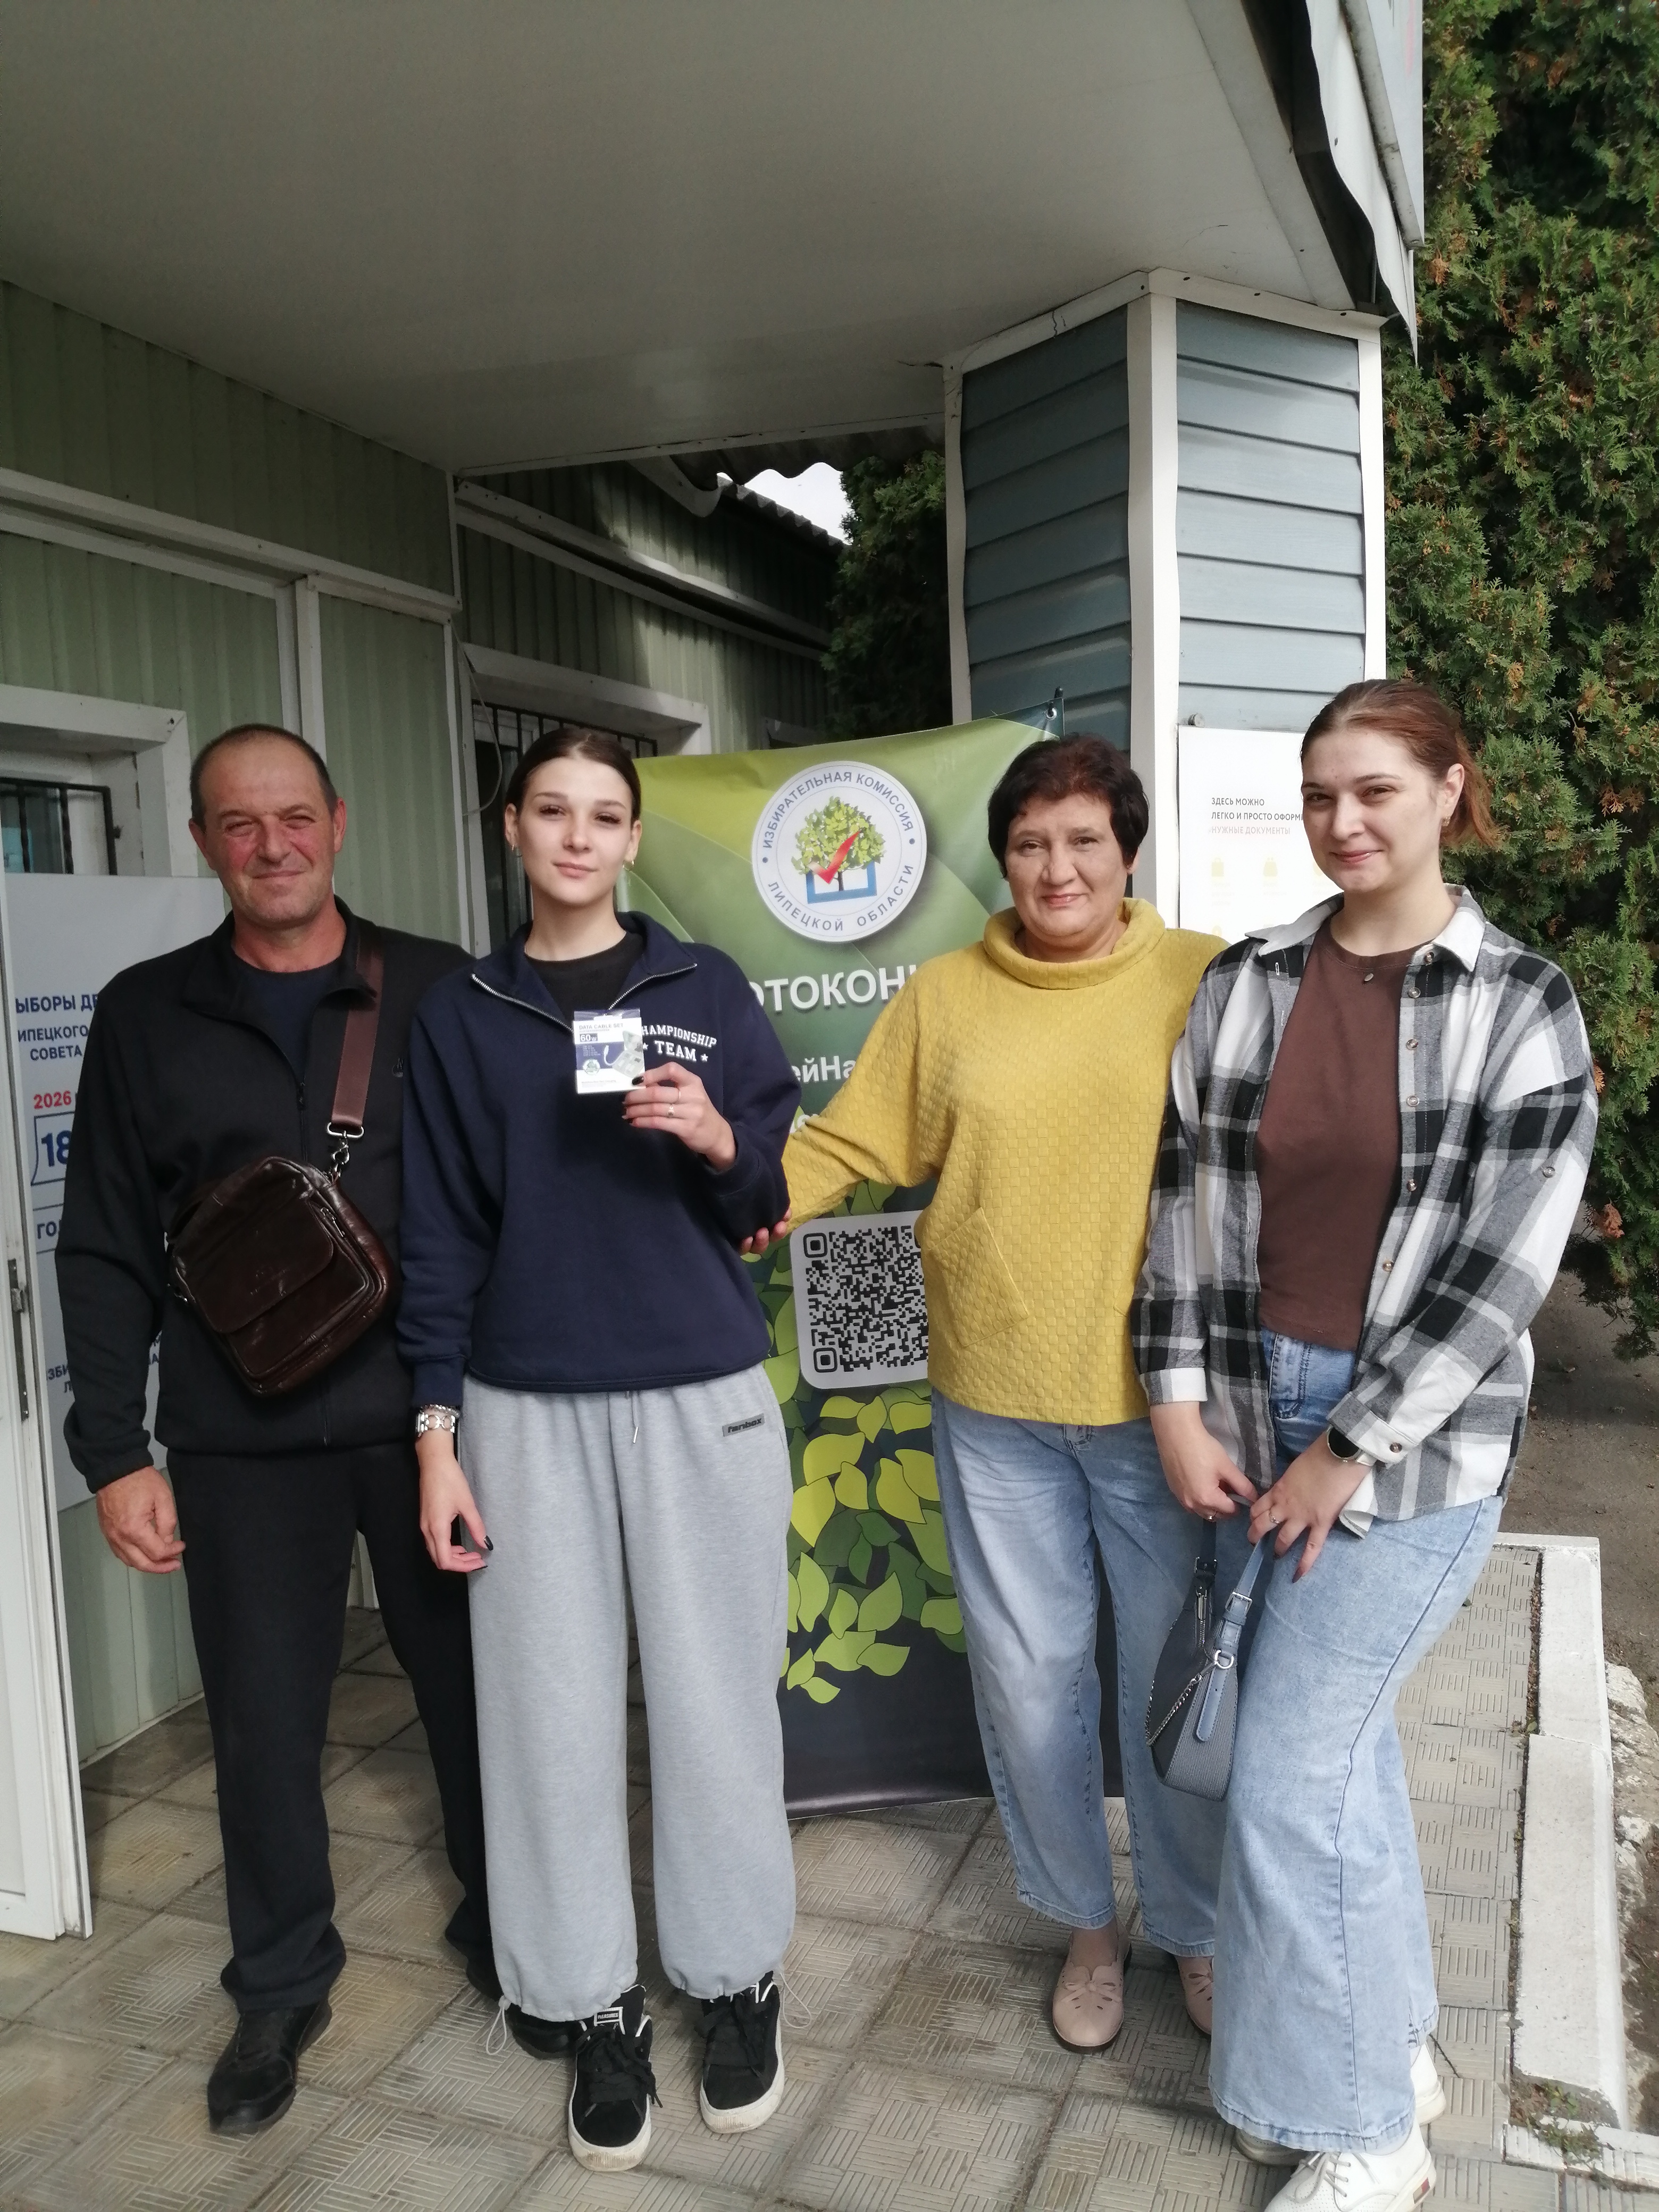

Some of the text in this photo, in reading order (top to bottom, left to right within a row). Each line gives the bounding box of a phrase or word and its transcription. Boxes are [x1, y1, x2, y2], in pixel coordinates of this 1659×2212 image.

[763, 772, 914, 849] ИЗБИРАТЕЛЬНАЯ КОМИССИЯ
[768, 865, 914, 932] ЛИПЕЦКОЙ ОБЛАСТИ
[30, 1044, 82, 1061] СОВЕТА
[654, 1040, 697, 1062] TEAM
[33, 1090, 72, 1109] 2026
[41, 1130, 71, 1167] 18
[37, 1219, 61, 1239] ГО
